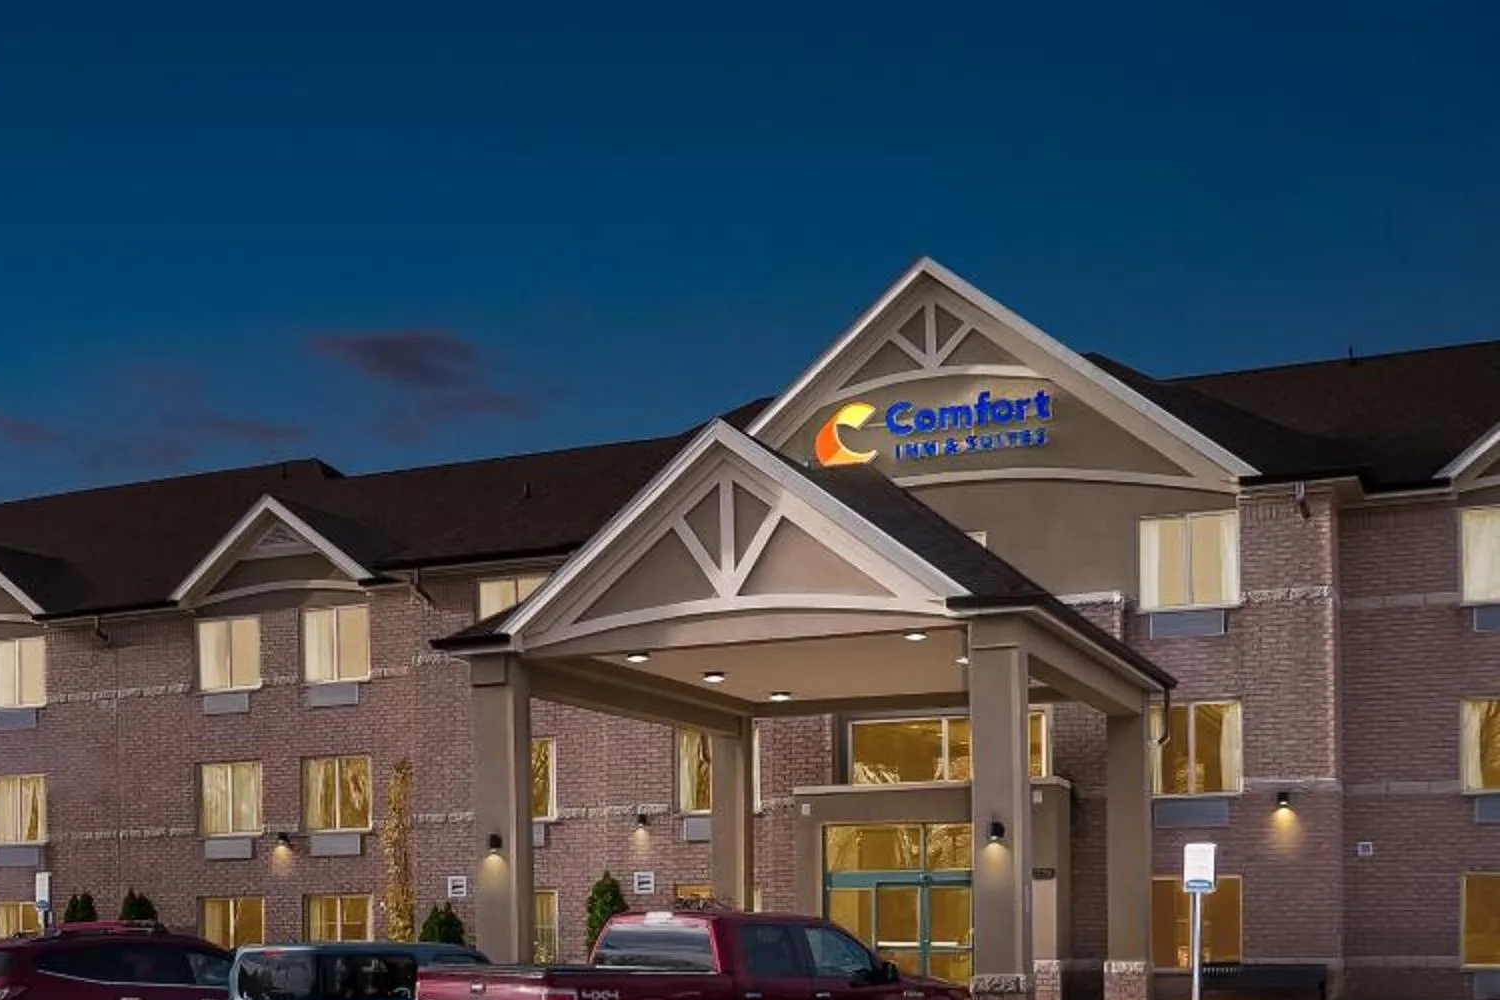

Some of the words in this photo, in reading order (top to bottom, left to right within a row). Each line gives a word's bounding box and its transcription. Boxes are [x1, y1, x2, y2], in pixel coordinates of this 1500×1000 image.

[885, 390, 1051, 436] Comfort
[895, 442, 939, 461] INN
[965, 427, 1047, 450] SUITES
